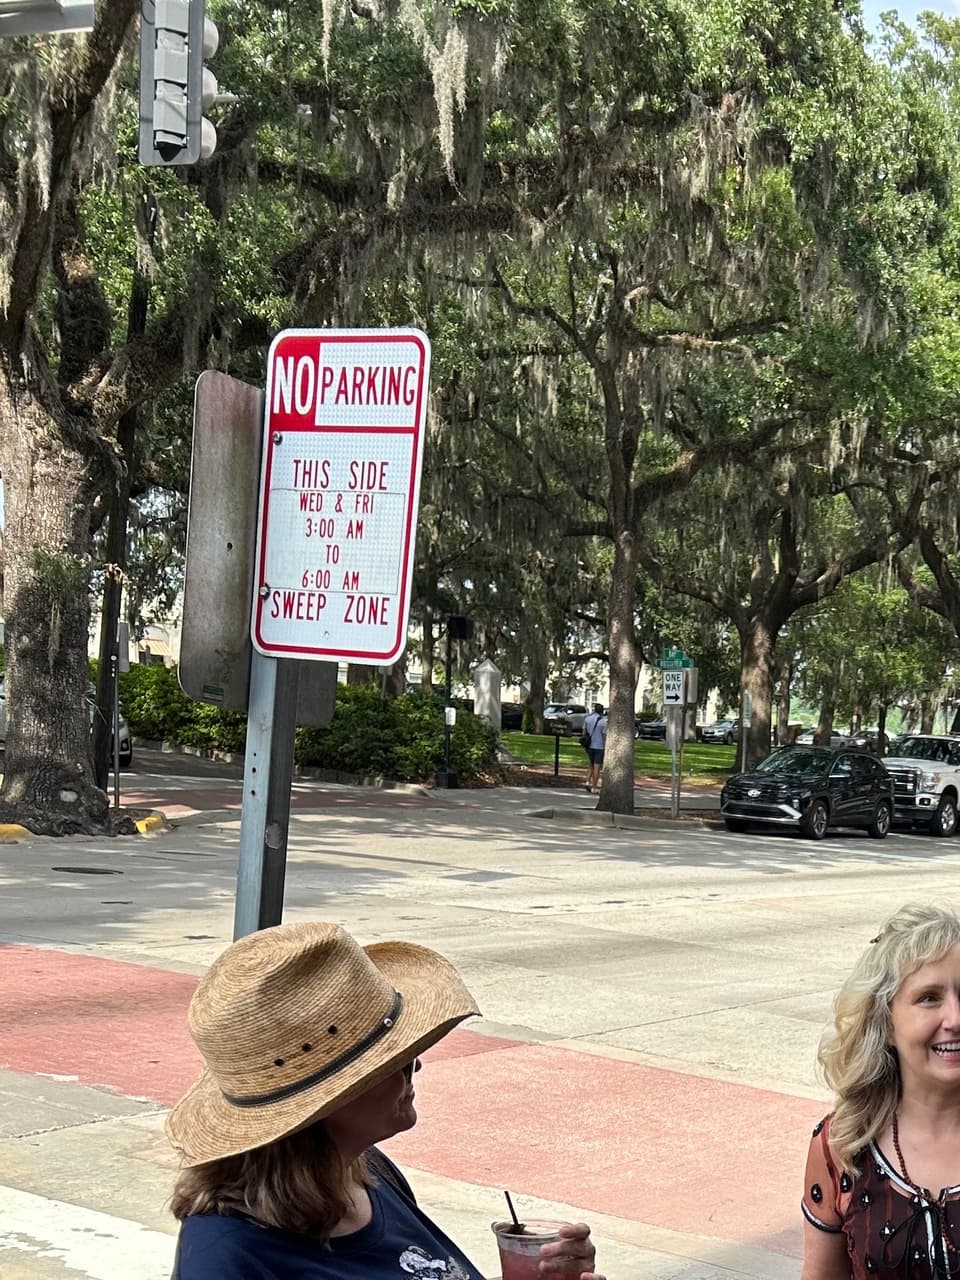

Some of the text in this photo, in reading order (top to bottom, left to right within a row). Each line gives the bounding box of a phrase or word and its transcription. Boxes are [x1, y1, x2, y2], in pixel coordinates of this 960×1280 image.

[273, 355, 417, 415] NO PARKING
[293, 459, 390, 490] THIS SIDE
[300, 492, 375, 514] WED & FRI
[305, 518, 364, 540] 3:00 AM
[325, 544, 340, 564] TO
[301, 569, 360, 591] 6:00 AM
[271, 591, 391, 626] SWEEP ZONE
[665, 673, 682, 682] ONE
[665, 683, 682, 691] WAY
